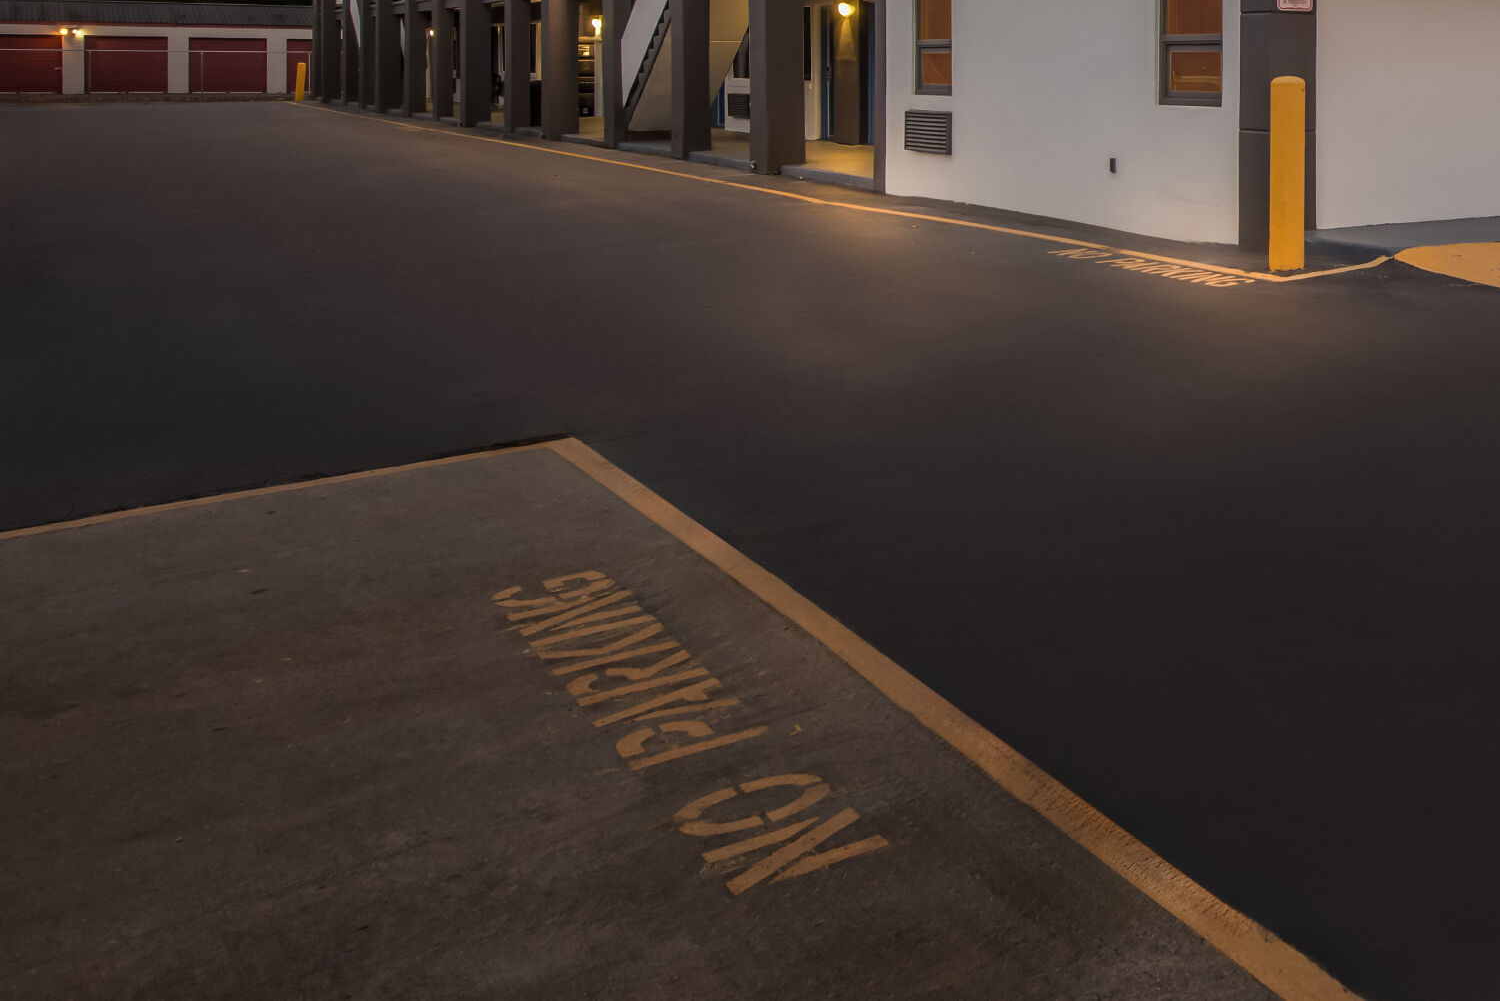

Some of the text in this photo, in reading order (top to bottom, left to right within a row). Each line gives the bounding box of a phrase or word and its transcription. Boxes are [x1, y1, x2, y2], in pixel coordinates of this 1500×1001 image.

[1047, 248, 1256, 288] NO PARKING
[491, 569, 891, 896] NO PARKING
